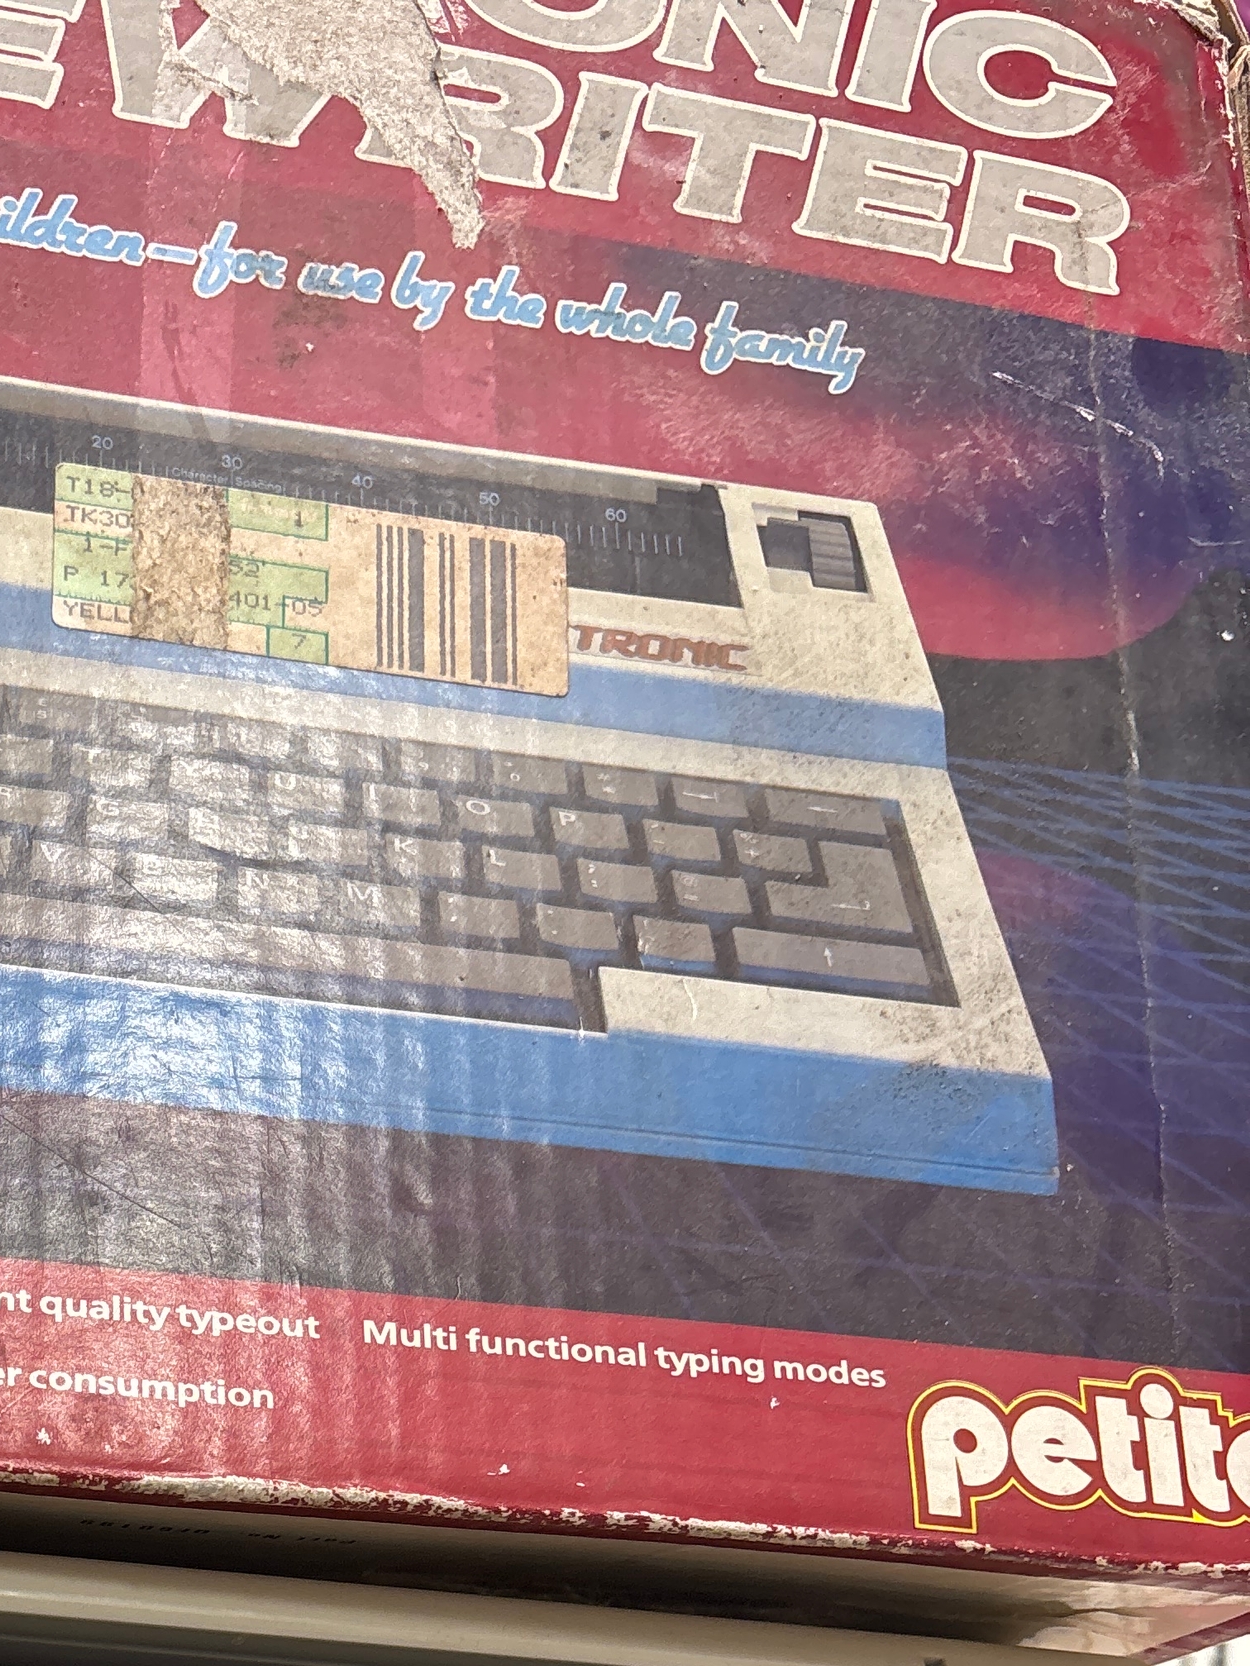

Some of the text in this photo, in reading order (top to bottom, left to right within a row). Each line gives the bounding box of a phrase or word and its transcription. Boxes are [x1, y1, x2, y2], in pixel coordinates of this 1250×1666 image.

[297, 261, 382, 306] use
[390, 251, 454, 332] by
[464, 264, 546, 330] the
[554, 283, 696, 354] whole
[701, 300, 866, 394] family
[92, 434, 113, 450] 20
[221, 454, 243, 471] 30
[351, 474, 374, 491] 40
[479, 491, 500, 508] 50
[605, 507, 627, 524] 60
[171, 467, 284, 493] Character Spacing
[63, 565, 79, 582] P
[274, 774, 297, 791] U
[465, 800, 491, 816] O
[558, 811, 576, 826] P
[40, 843, 62, 862] V
[489, 850, 506, 867] L
[39, 1294, 170, 1331] quality
[175, 1308, 320, 1340] typeout
[362, 1319, 888, 1390] Multi functional typing modes
[28, 1366, 276, 1410] consumption
[921, 1383, 1250, 1513] petit
